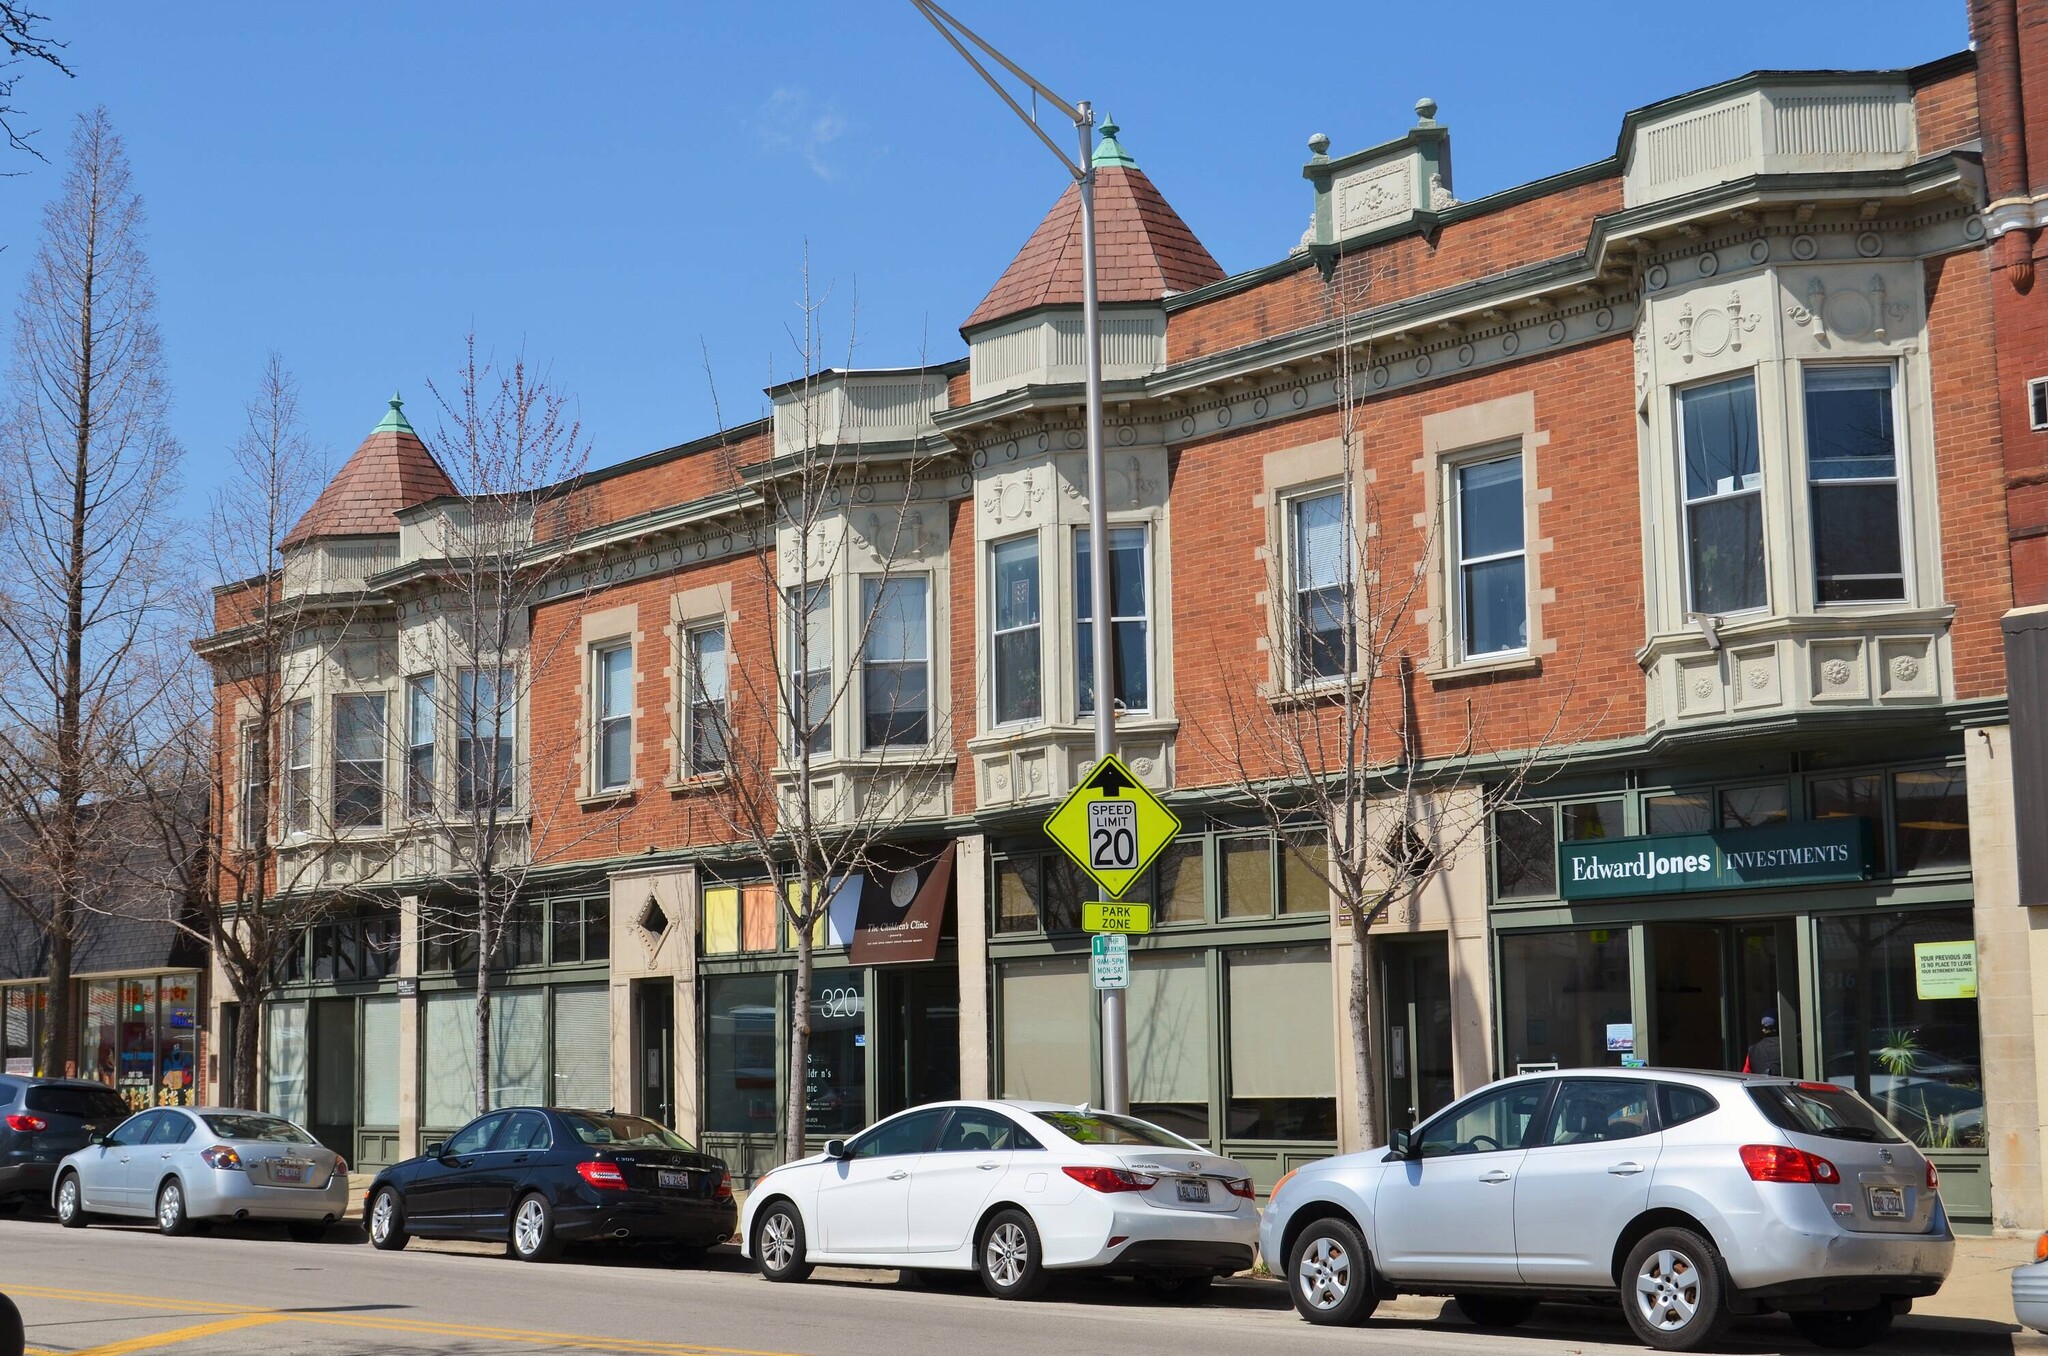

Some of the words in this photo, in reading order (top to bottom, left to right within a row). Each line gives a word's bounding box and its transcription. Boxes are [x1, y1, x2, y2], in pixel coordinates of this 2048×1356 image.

[1092, 805, 1132, 815] SPEED
[1096, 816, 1128, 827] LIMIT
[1093, 828, 1134, 866] 20
[1726, 844, 1849, 870] INVESTMENTS
[1102, 906, 1131, 917] PARK
[867, 923, 879, 933] The
[880, 922, 910, 932] Children's
[910, 920, 929, 930] Clinic
[1102, 918, 1131, 929] ZONE
[1096, 939, 1100, 953] 1
[1110, 937, 1120, 945] HR
[1097, 966, 1124, 974] MON-SAT
[821, 987, 858, 1018] 320
